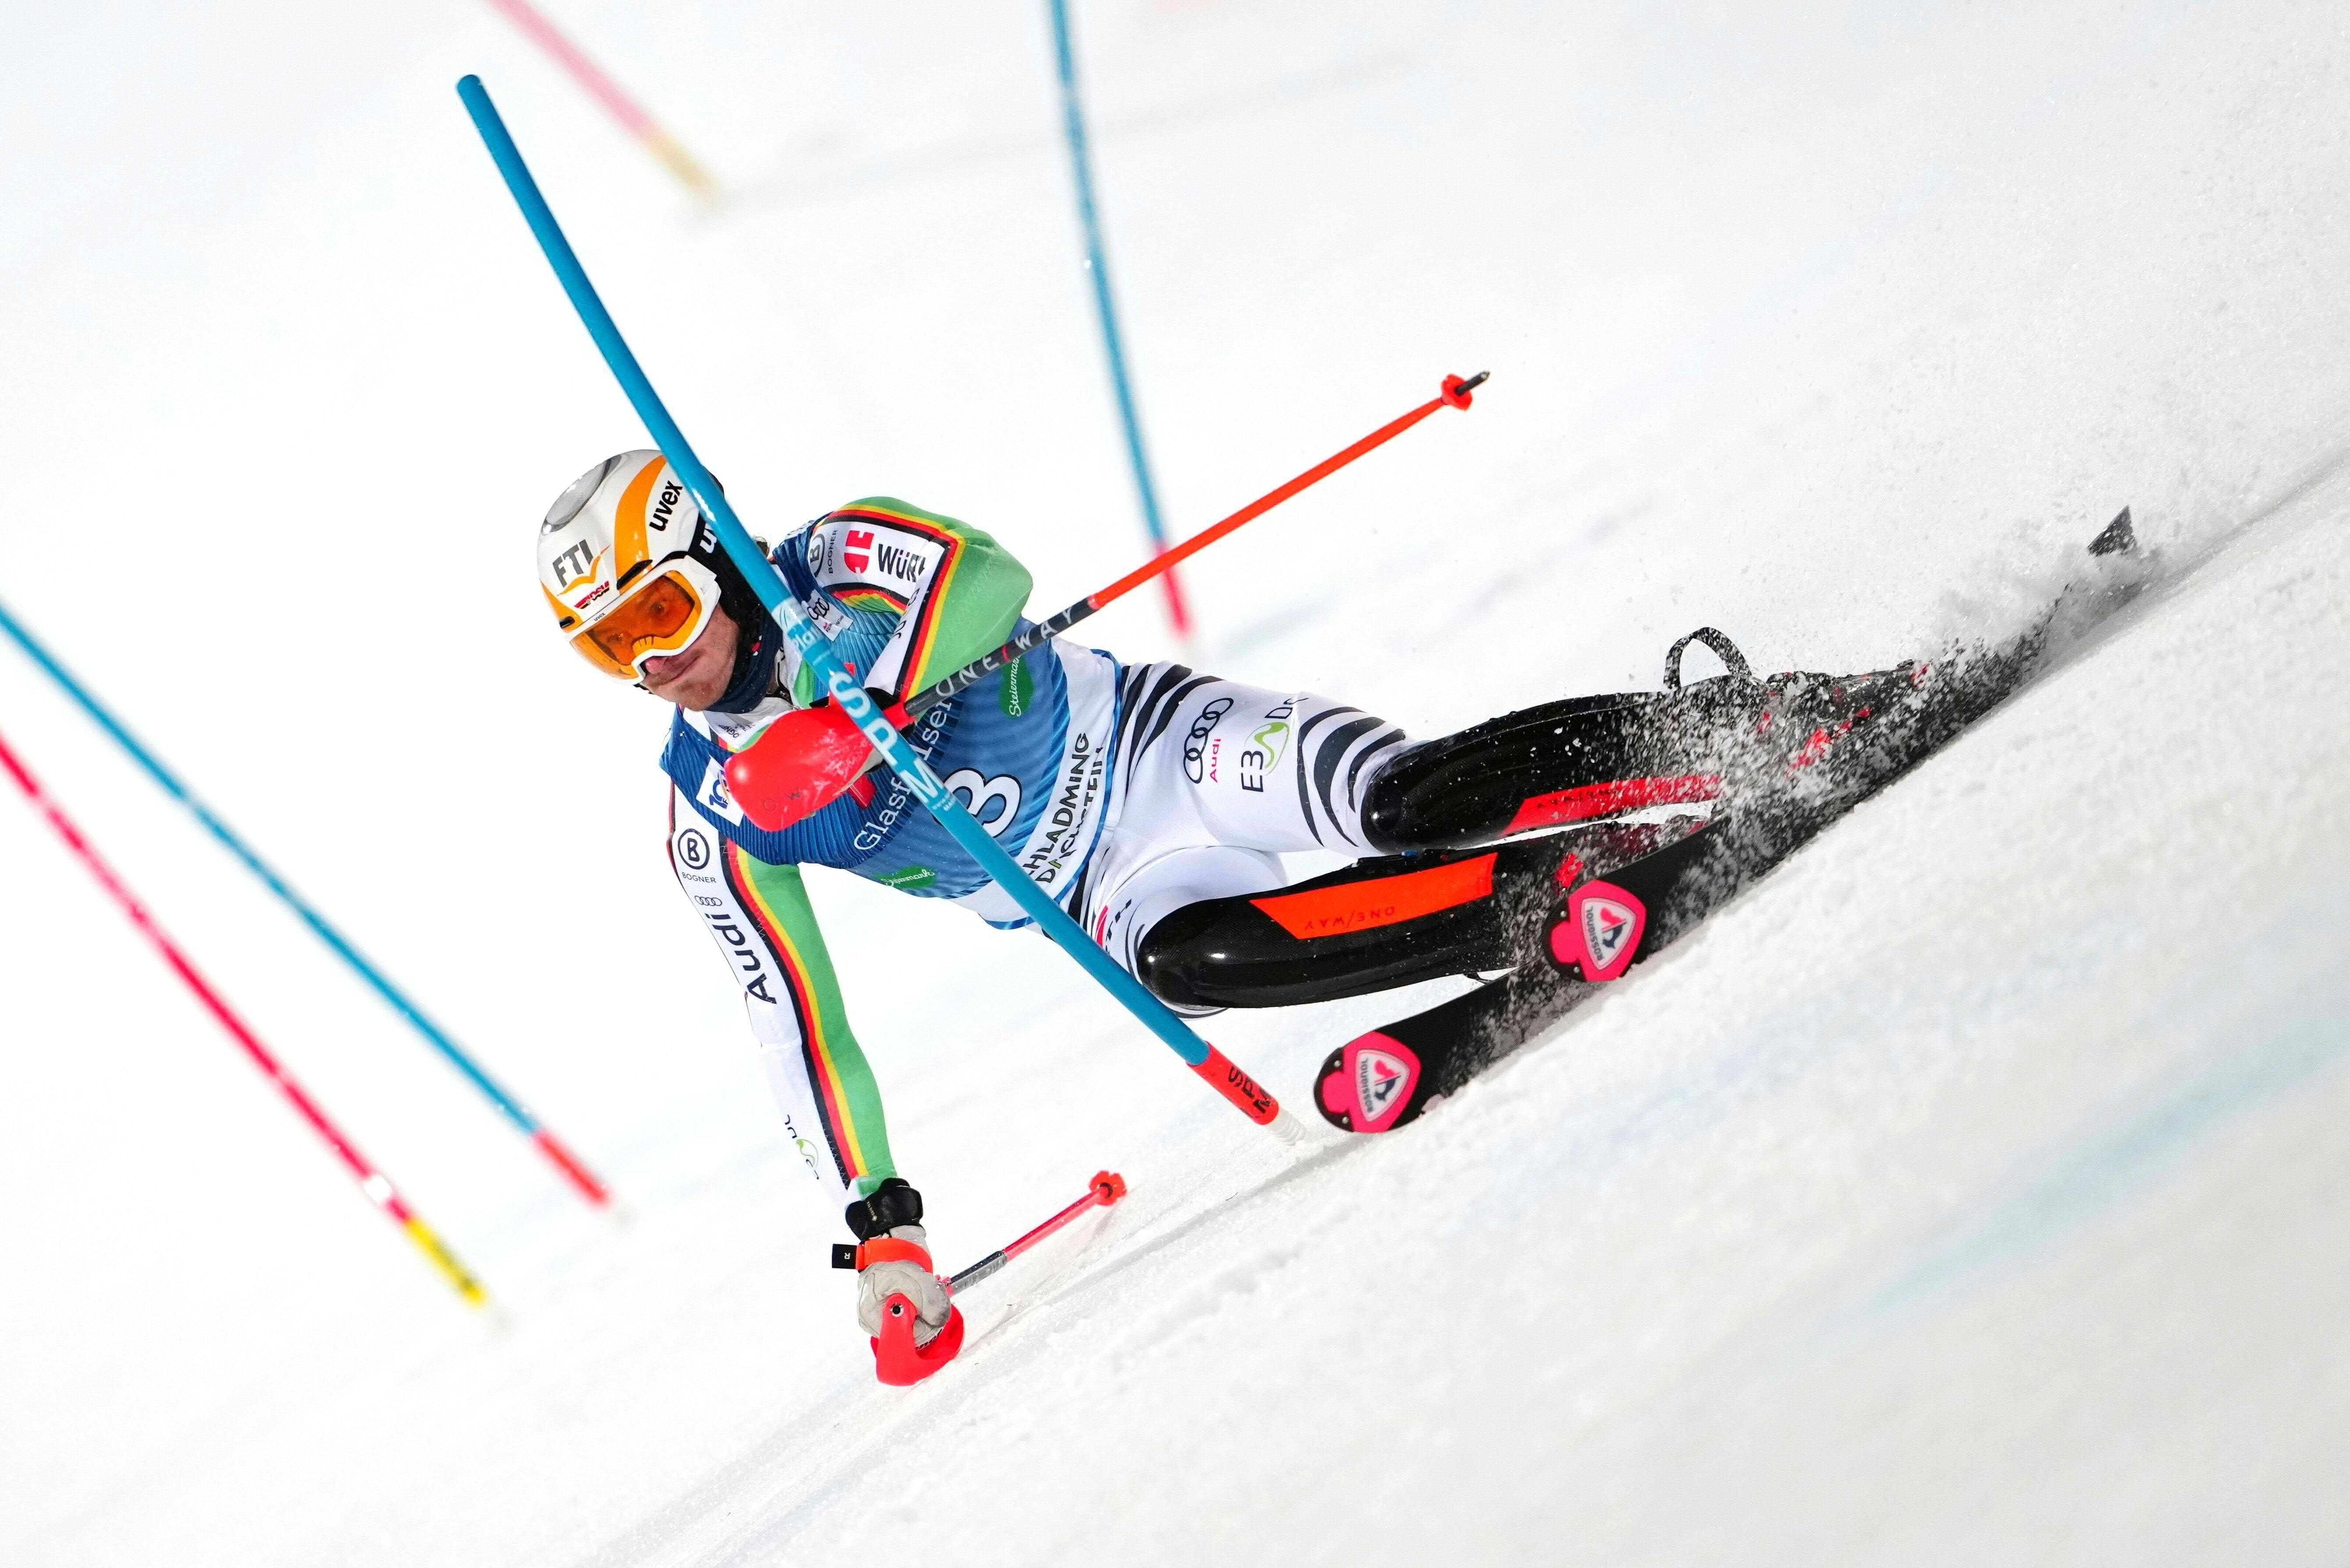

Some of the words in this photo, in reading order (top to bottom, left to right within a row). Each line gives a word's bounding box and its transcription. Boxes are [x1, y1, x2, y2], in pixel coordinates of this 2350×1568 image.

[648, 480, 683, 531] uvex
[552, 539, 594, 588] FTI
[827, 530, 838, 574] BOGNER
[593, 612, 606, 621] uvex
[828, 670, 945, 804] SPM
[1210, 738, 1221, 783] Audi
[1022, 733, 1090, 875] HLADMING
[682, 872, 716, 884] BOGNER
[705, 913, 777, 1005] Audi
